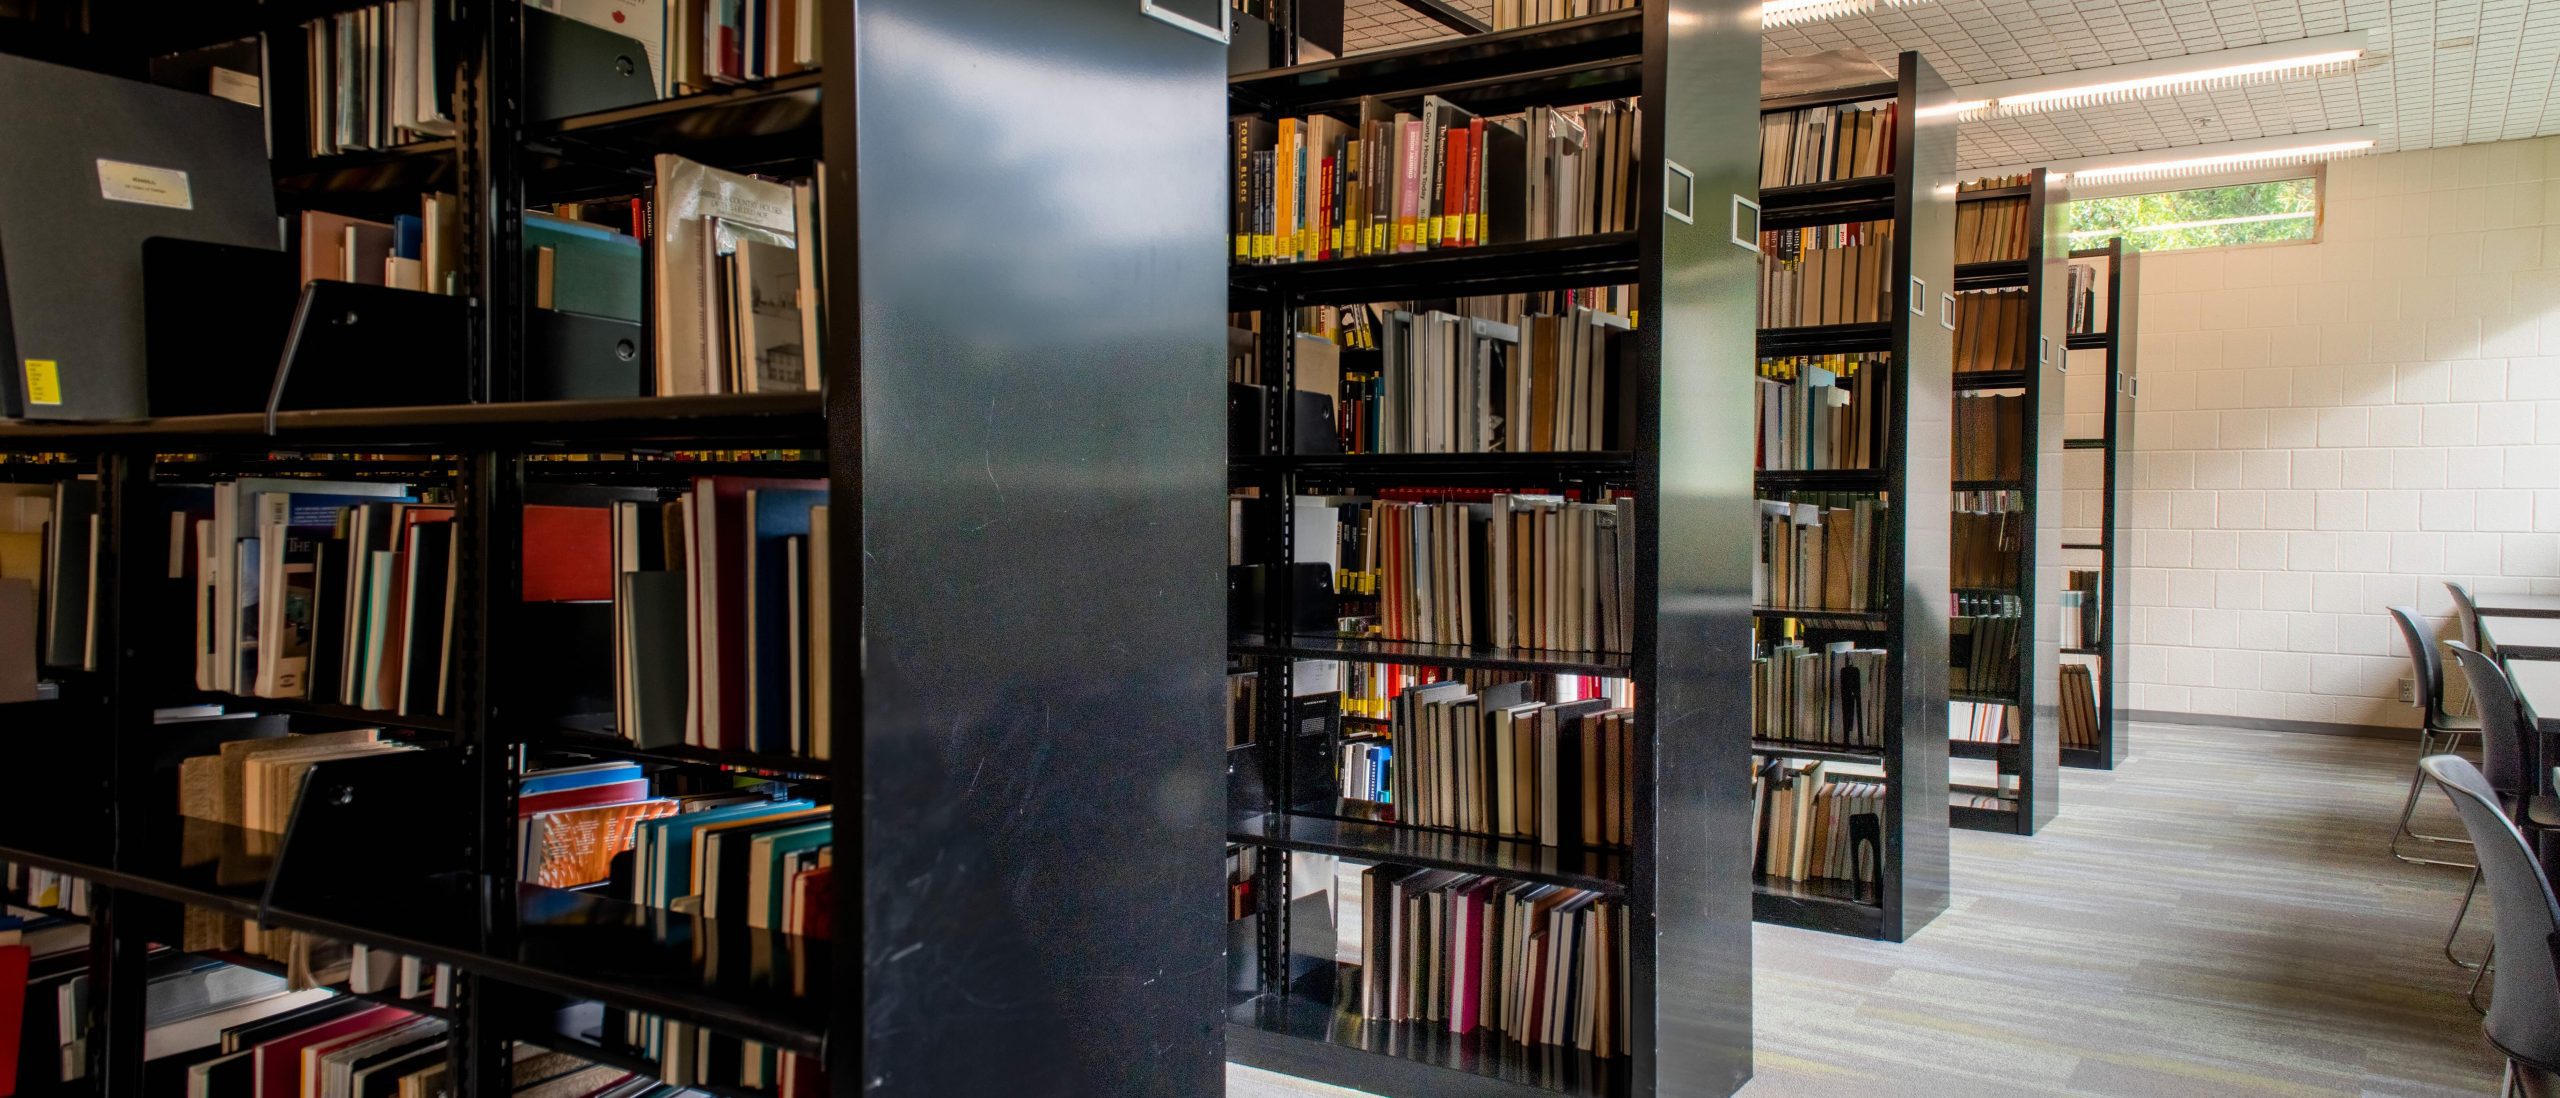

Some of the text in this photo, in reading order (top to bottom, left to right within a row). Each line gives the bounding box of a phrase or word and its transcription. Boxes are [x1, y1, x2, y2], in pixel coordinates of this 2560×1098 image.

[1240, 121, 1248, 160] TOWER
[1424, 111, 1432, 143] Country
[1439, 124, 1447, 136] The
[1422, 145, 1430, 175] Houses
[1420, 177, 1428, 201] Today
[287, 537, 312, 553] THE
